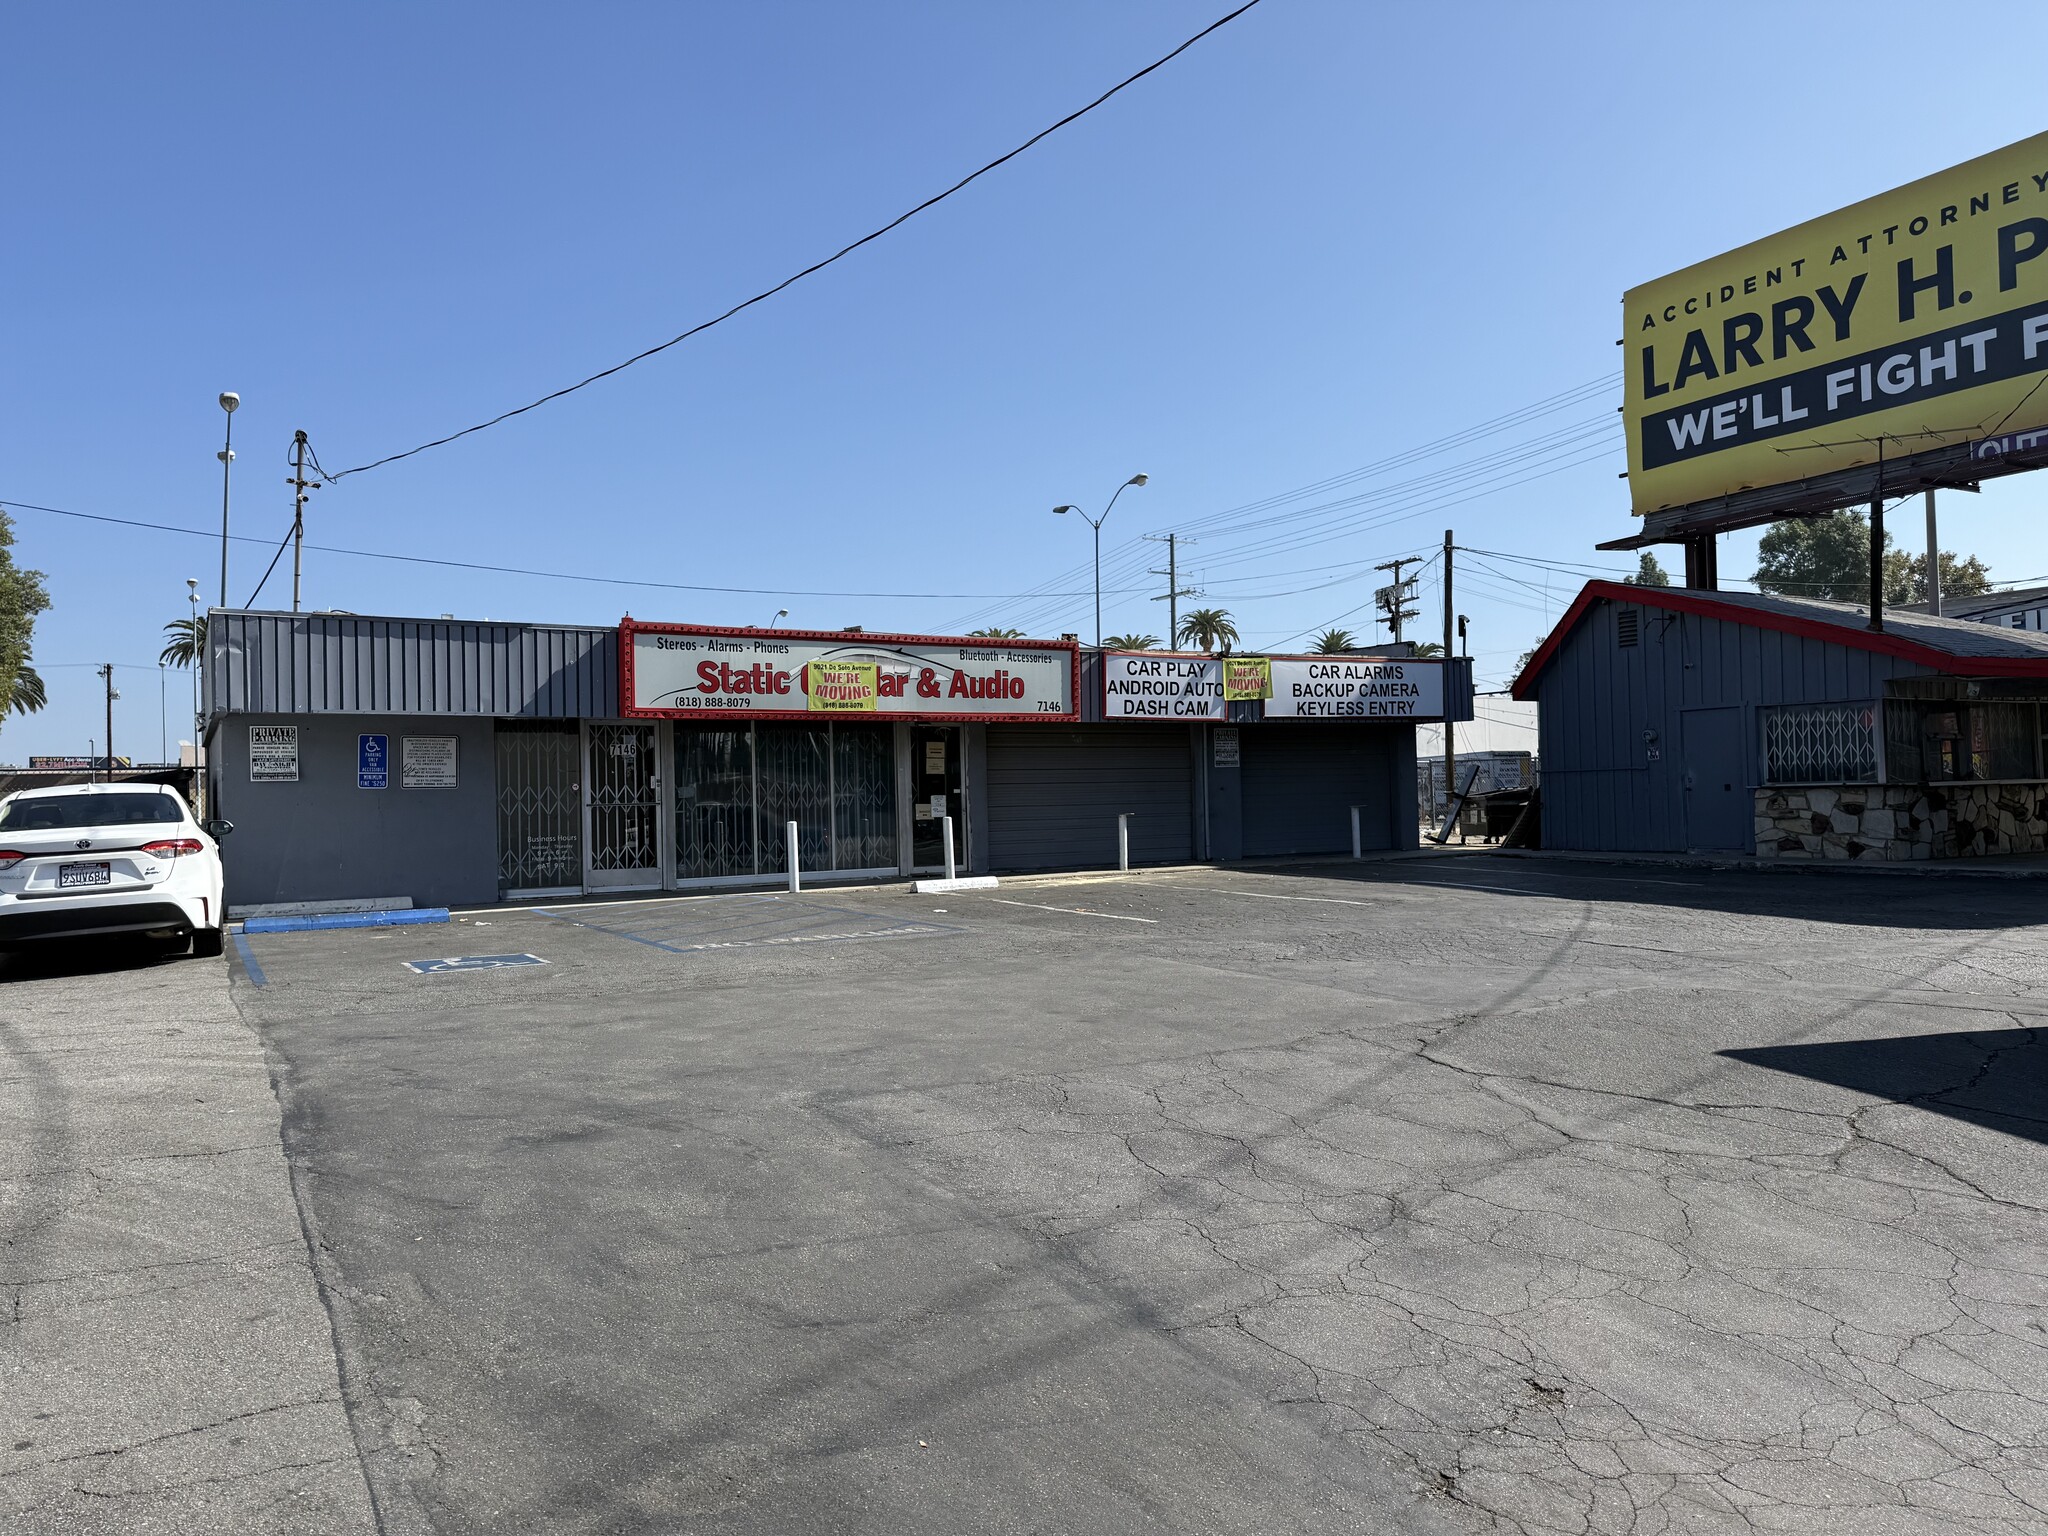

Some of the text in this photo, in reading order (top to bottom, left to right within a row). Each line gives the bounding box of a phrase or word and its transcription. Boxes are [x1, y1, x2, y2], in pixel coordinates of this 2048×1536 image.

[1642, 259, 1805, 331] ACCIDENT
[1642, 272, 1868, 400] LARRY
[1897, 244, 1973, 323] H.
[1666, 385, 1809, 451] WE'LL
[1825, 327, 1998, 412] FIGHT
[657, 637, 697, 651] Stereos
[708, 639, 743, 653] Alarms
[754, 641, 789, 655] Phones
[959, 649, 999, 662] Bluetooth
[1007, 651, 1052, 664] Accessories
[1127, 661, 1207, 678] CAR PLAY
[1309, 664, 1404, 679] CAR ALARMS
[696, 660, 791, 695] Static
[916, 667, 940, 698] &
[948, 669, 1025, 699] Audio
[823, 672, 861, 684] WE'RE
[1228, 677, 1267, 690] MOVING
[815, 685, 871, 701] MOVING
[1107, 680, 1224, 697] ANDROID AUTO
[1293, 683, 1419, 697] BACKUP CAMERA
[675, 697, 751, 708] (818) 888-8079
[1037, 701, 1061, 712] 7146
[1124, 700, 1208, 715] DASH CAM
[1297, 701, 1415, 715] KEYLESS ENTRY
[253, 728, 295, 736] PRIVATE
[611, 745, 635, 755] 7146
[63, 871, 107, 883] 9SUV684
